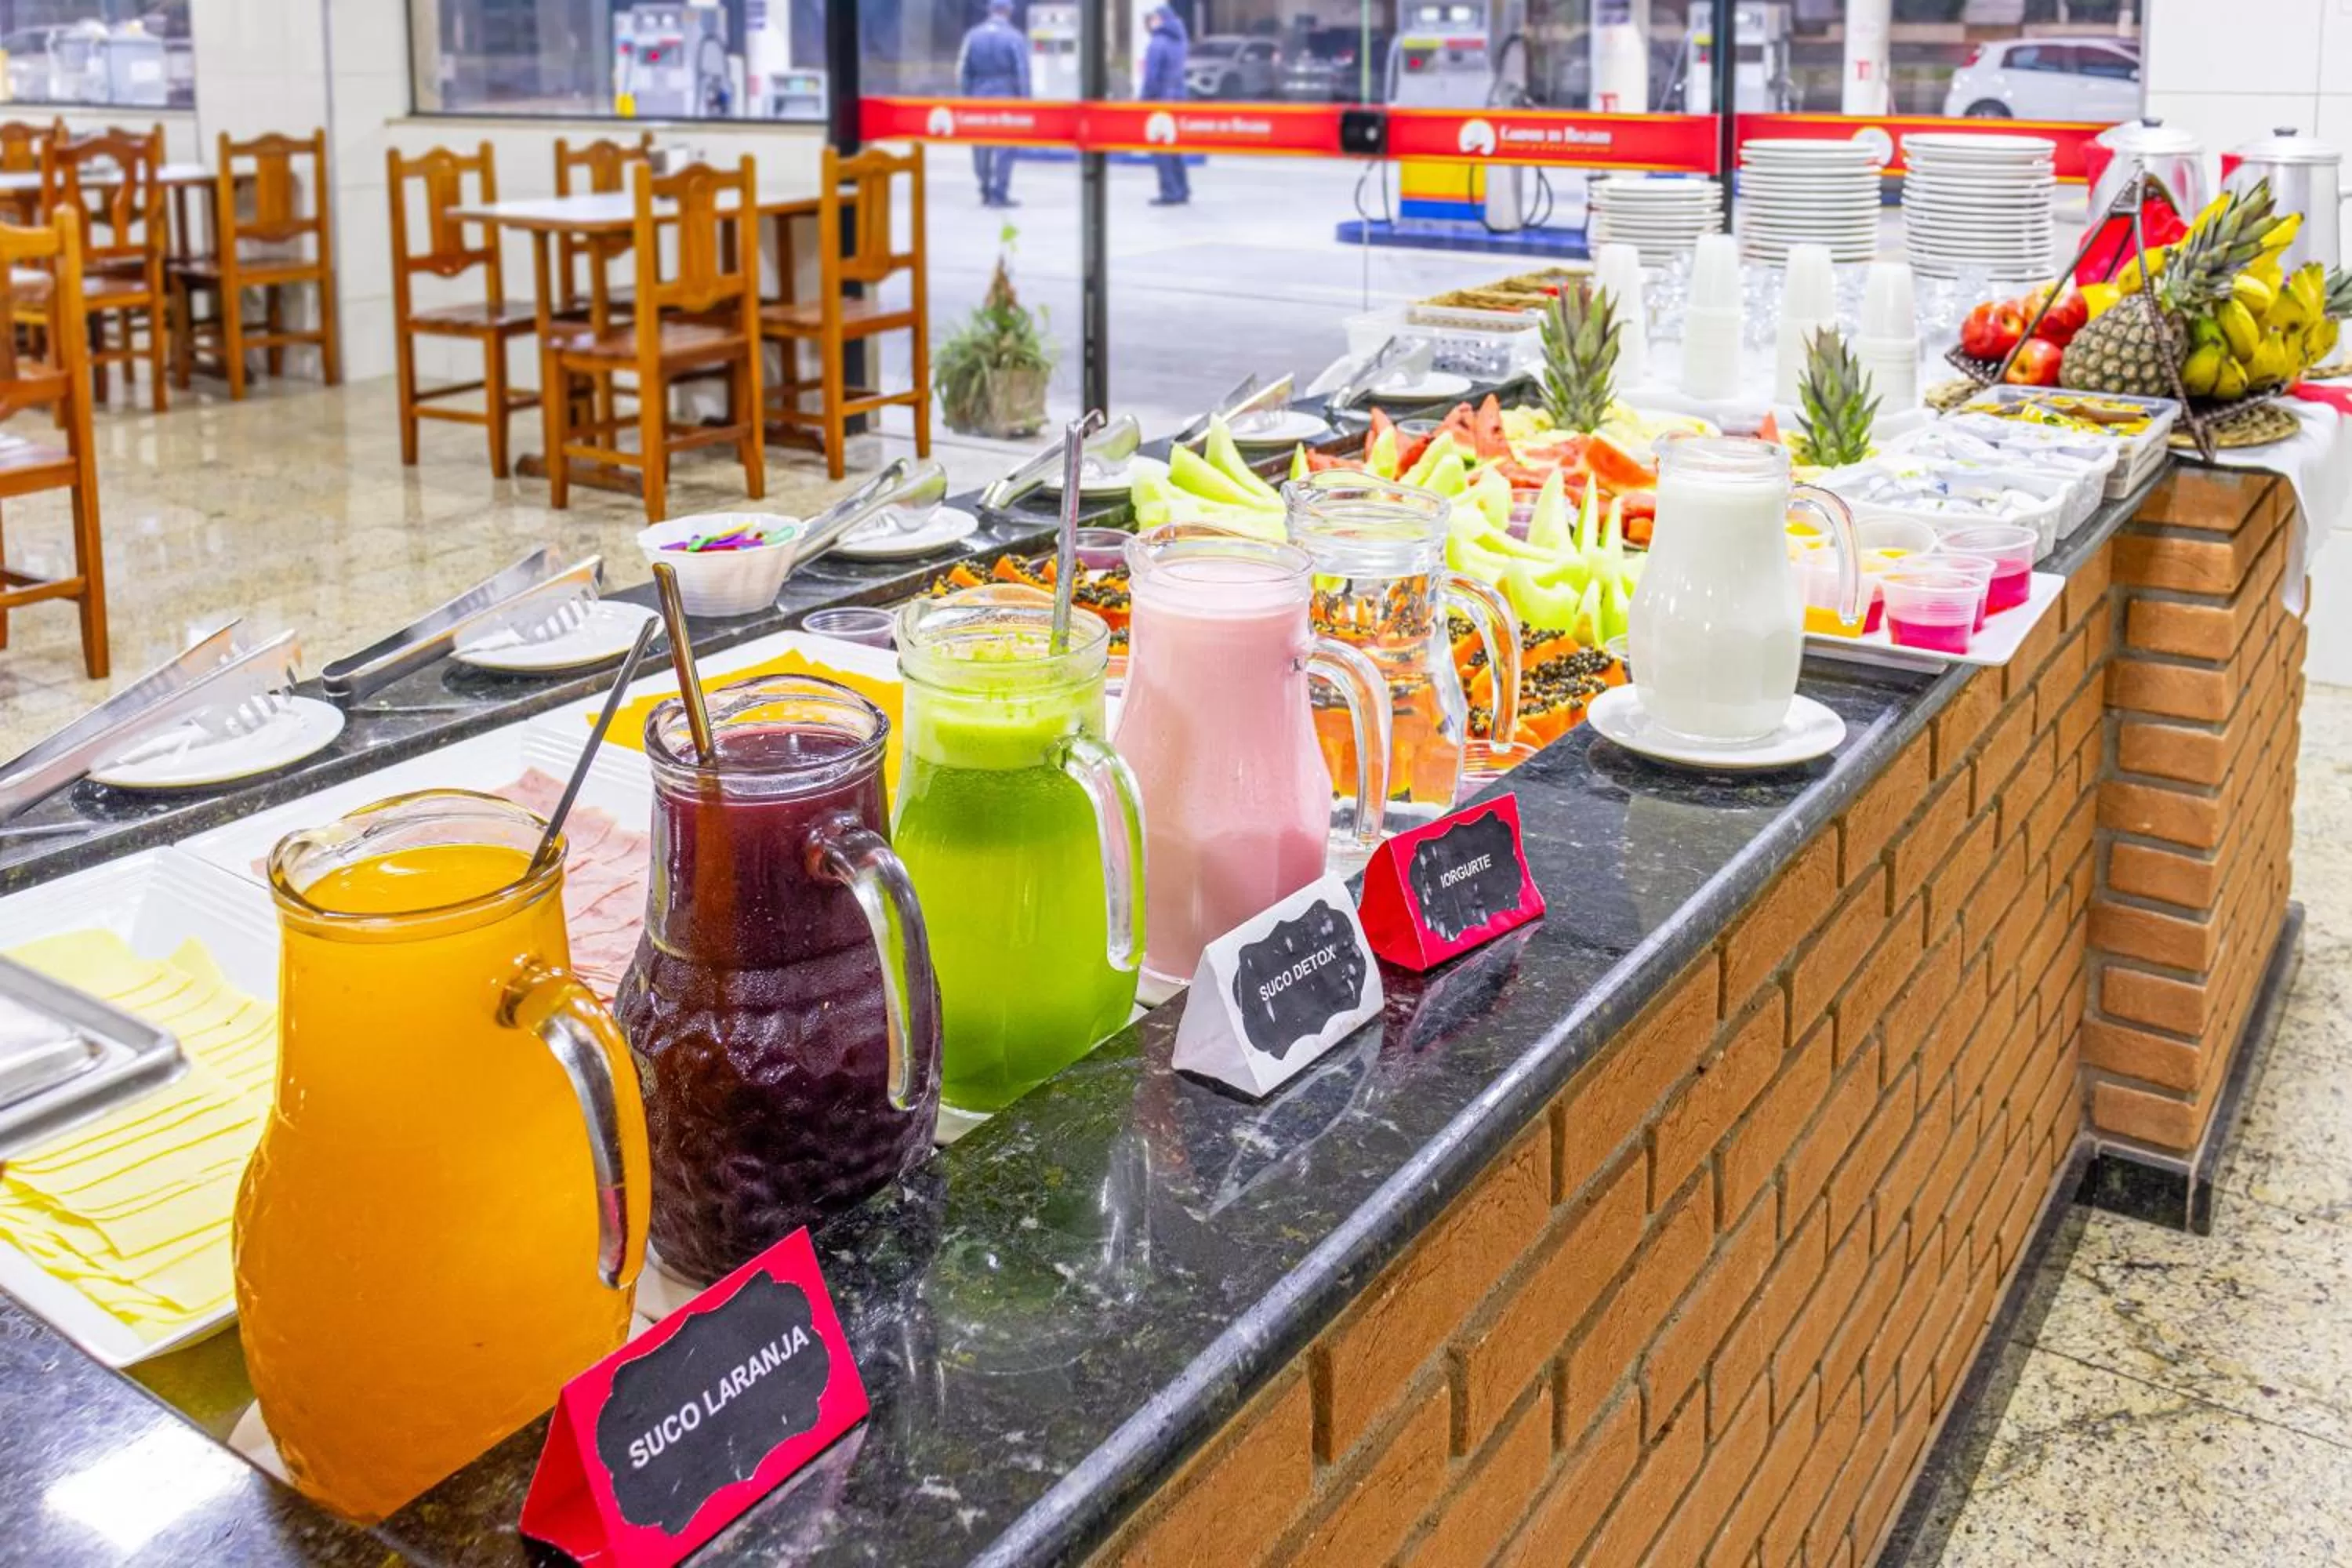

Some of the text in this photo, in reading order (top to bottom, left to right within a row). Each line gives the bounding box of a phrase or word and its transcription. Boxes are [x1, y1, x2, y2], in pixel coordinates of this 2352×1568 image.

[1440, 854, 1492, 888] IORGURTE
[1260, 945, 1336, 1001] SUCO DETOX
[629, 1326, 809, 1469] SUCO LARANJA
